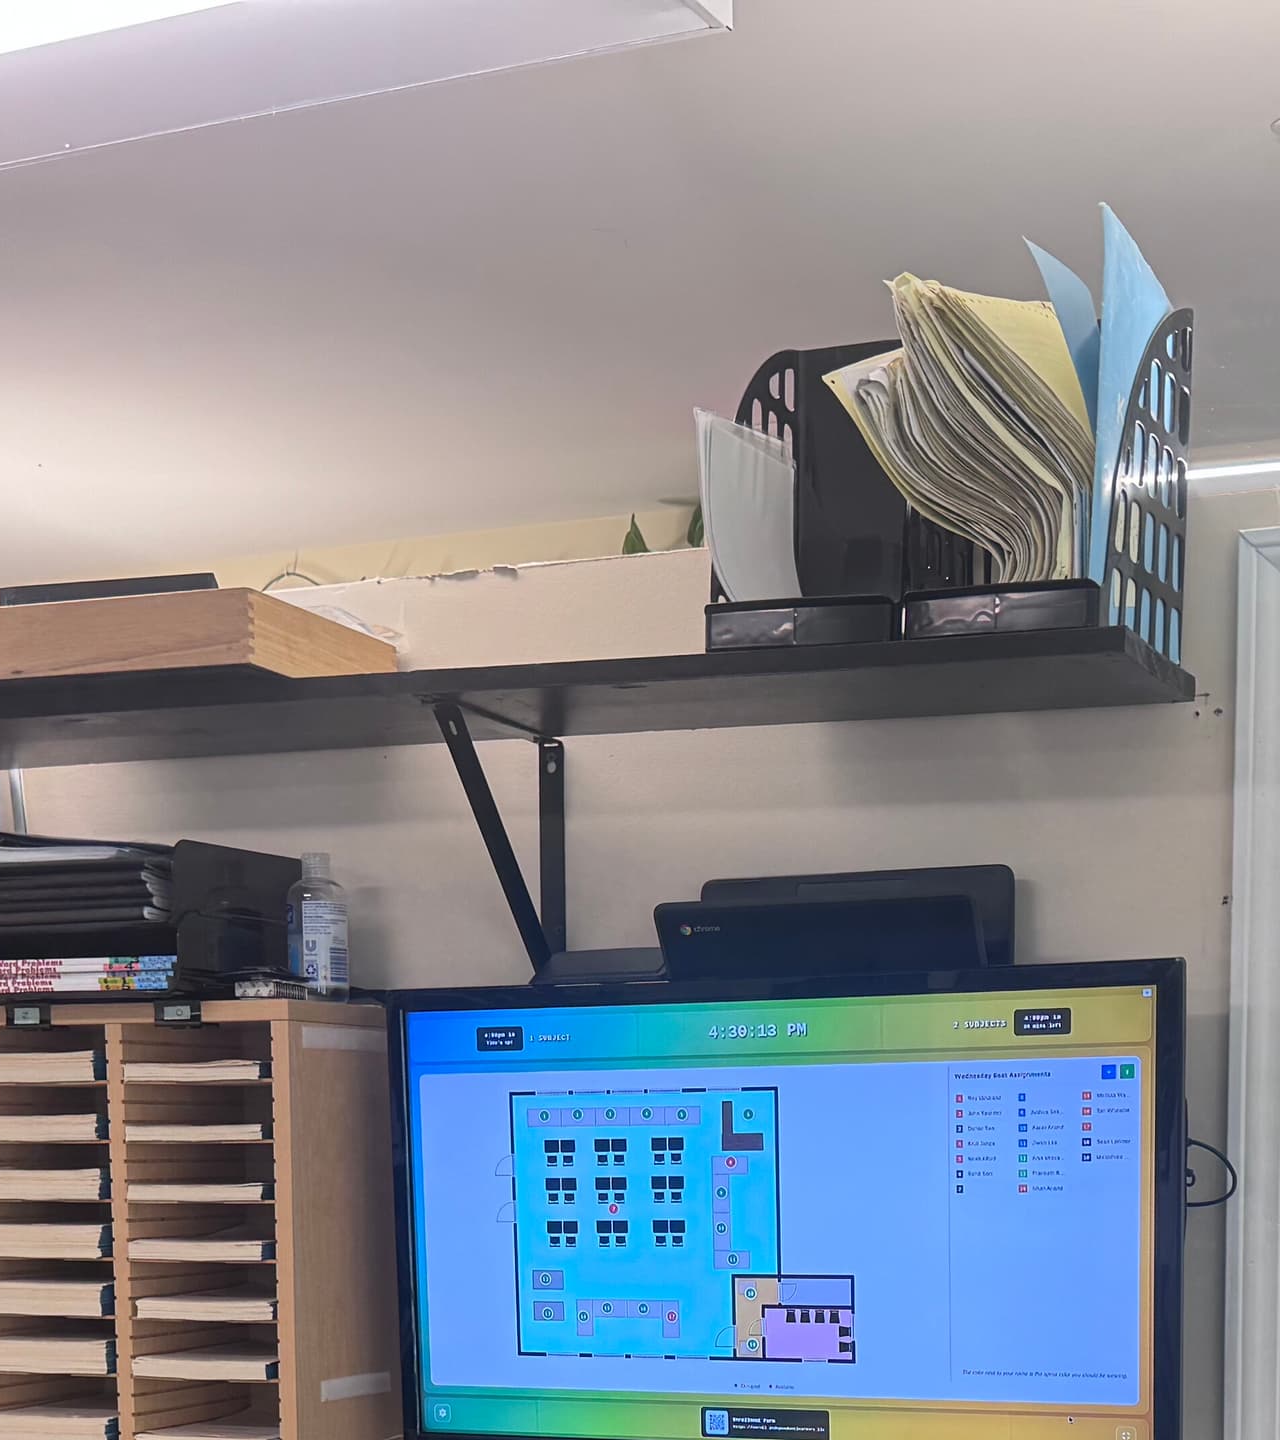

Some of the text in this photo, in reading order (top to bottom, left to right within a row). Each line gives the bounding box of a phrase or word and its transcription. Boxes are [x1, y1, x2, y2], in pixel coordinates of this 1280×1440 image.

[22, 959, 62, 967] Problems
[708, 1022, 808, 1039] 4:30:13 PM
